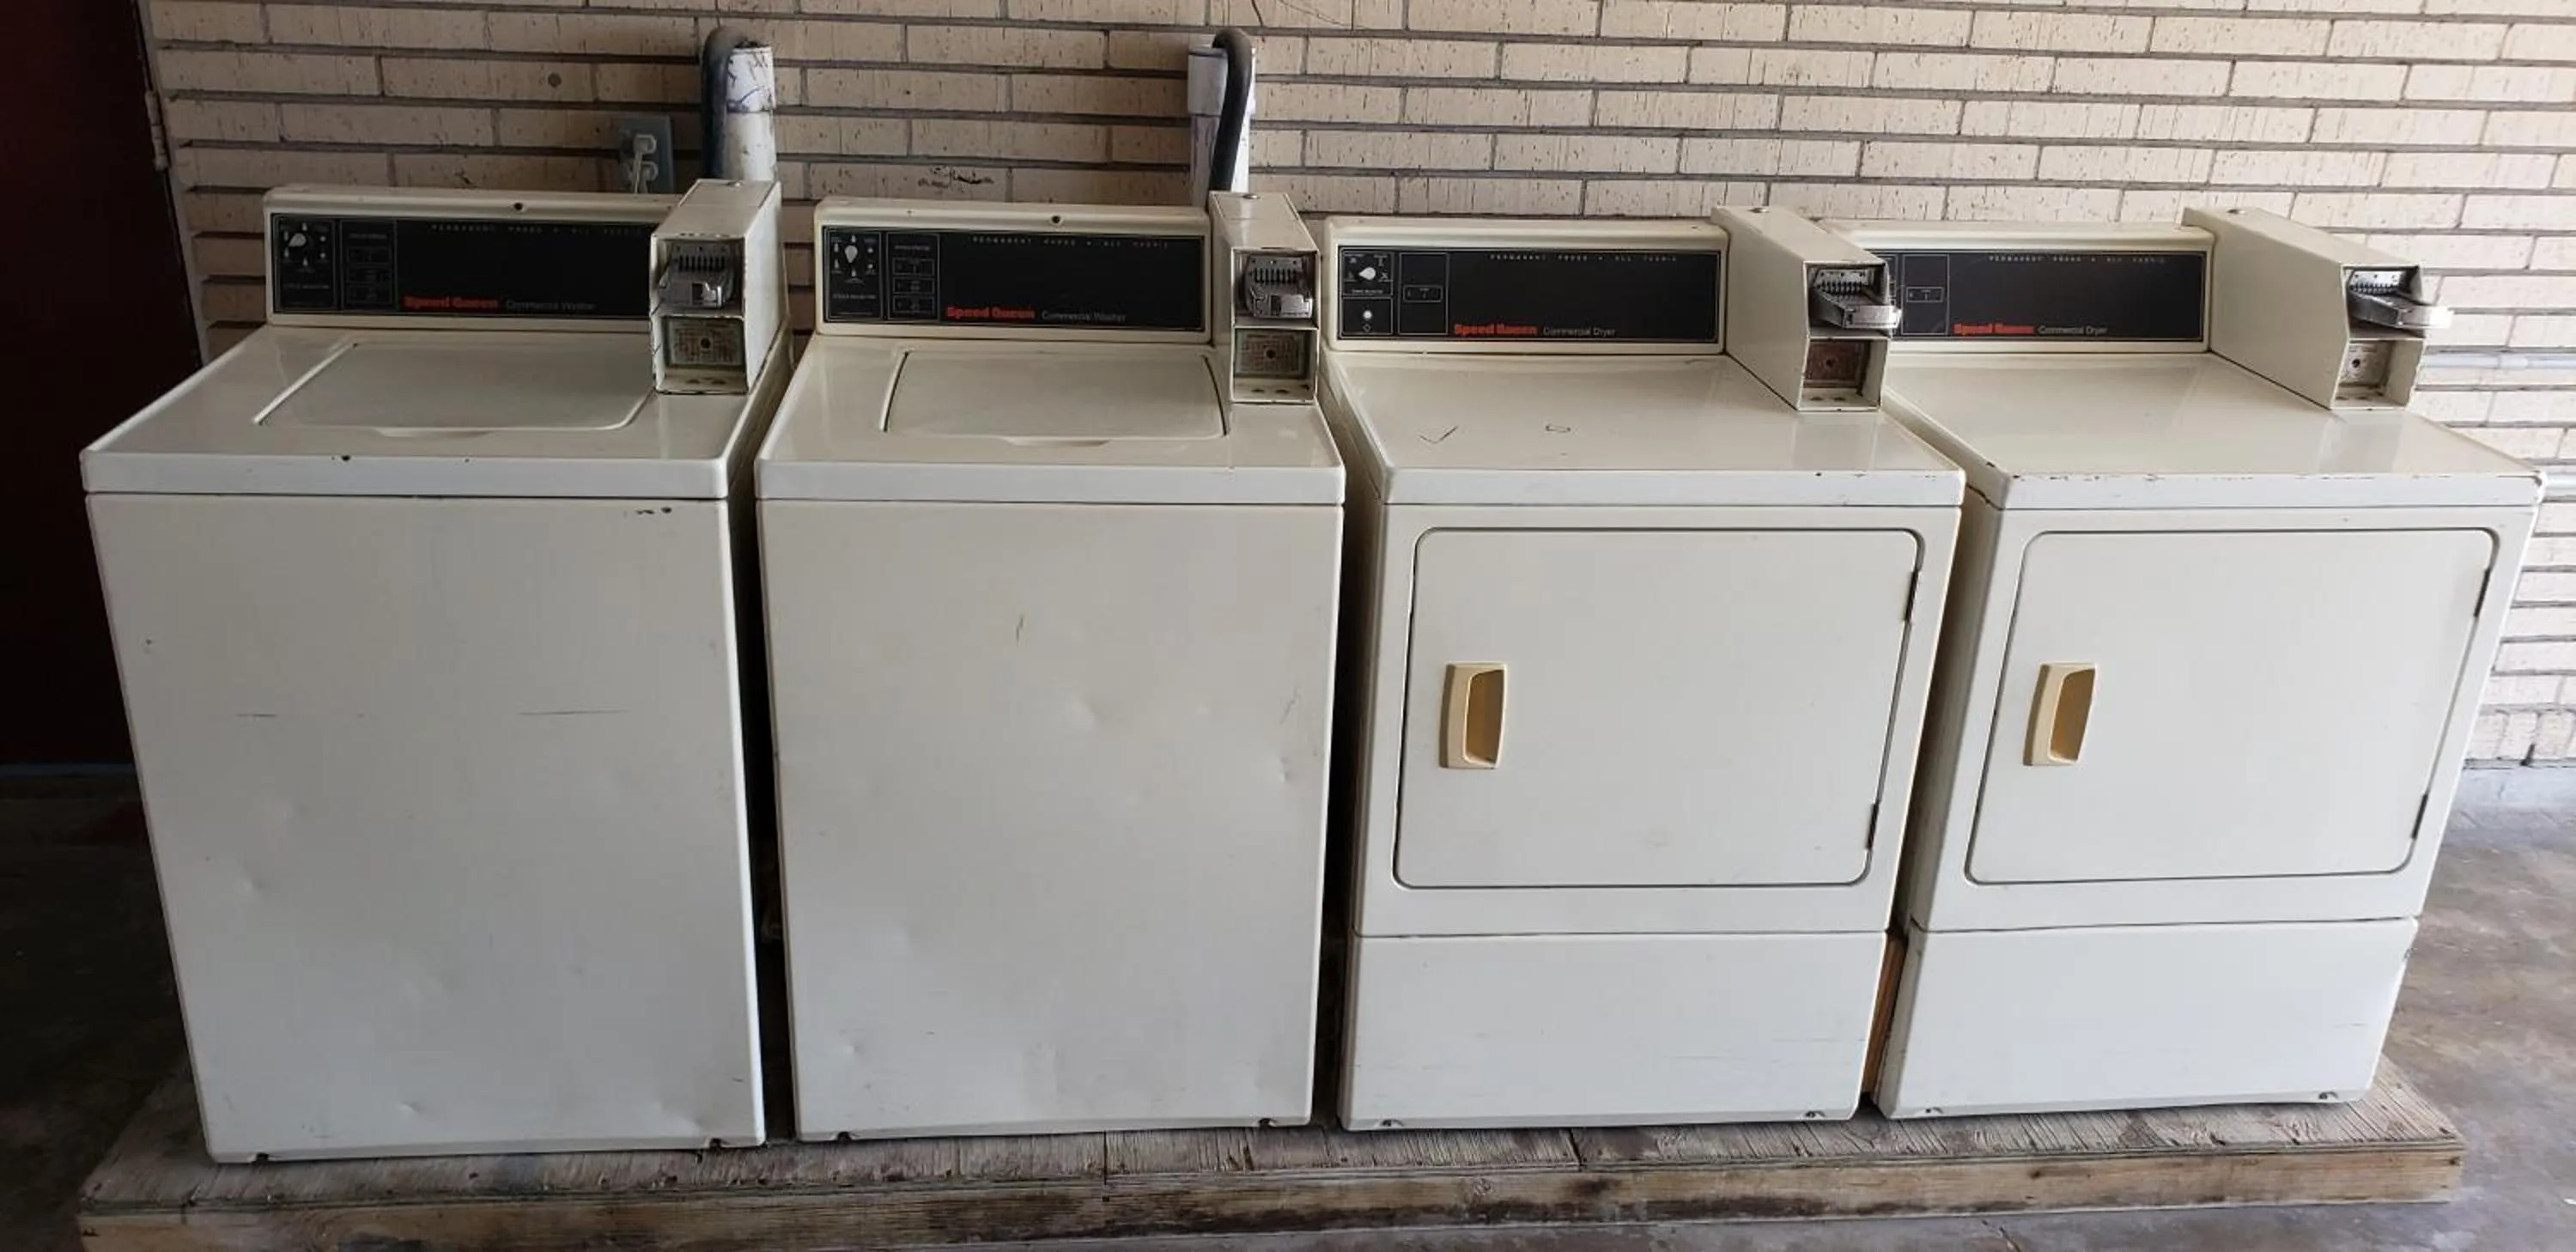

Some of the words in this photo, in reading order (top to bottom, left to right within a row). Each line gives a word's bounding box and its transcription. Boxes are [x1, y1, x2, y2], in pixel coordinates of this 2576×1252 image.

[403, 295, 451, 311] Speed
[452, 296, 499, 309] Queen
[946, 306, 990, 320] Speed
[991, 307, 1036, 319] Queen
[1041, 309, 1090, 321] Commercial
[1455, 323, 1495, 337] Speed
[1496, 323, 1539, 335] Queen
[1543, 325, 1591, 336] Commercial
[1593, 326, 1616, 337] Dryer
[1953, 322, 1993, 336] Speed
[1994, 322, 2034, 334] Queen
[2038, 325, 2085, 335] Commercial
[2086, 325, 2109, 337] Dryer
